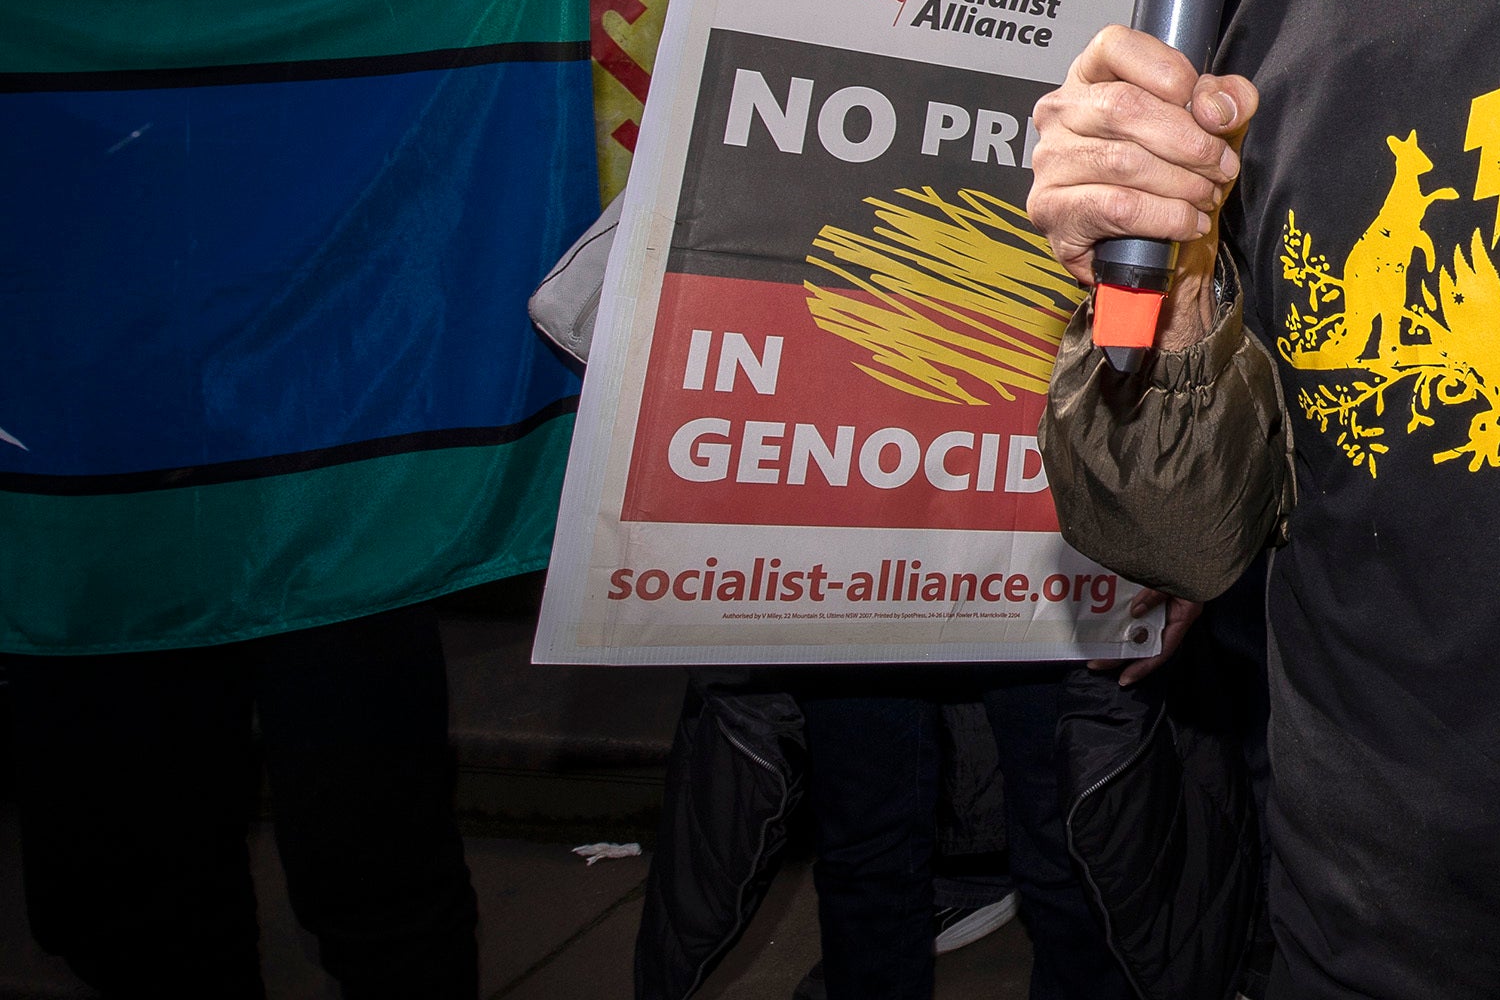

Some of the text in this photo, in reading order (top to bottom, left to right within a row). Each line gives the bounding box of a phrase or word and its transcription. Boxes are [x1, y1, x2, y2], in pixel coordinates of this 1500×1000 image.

[723, 68, 1040, 169] NO PRI
[682, 329, 784, 395] IN
[667, 417, 1050, 493] GENOCID
[607, 556, 1117, 613] socialist-alliance.org
